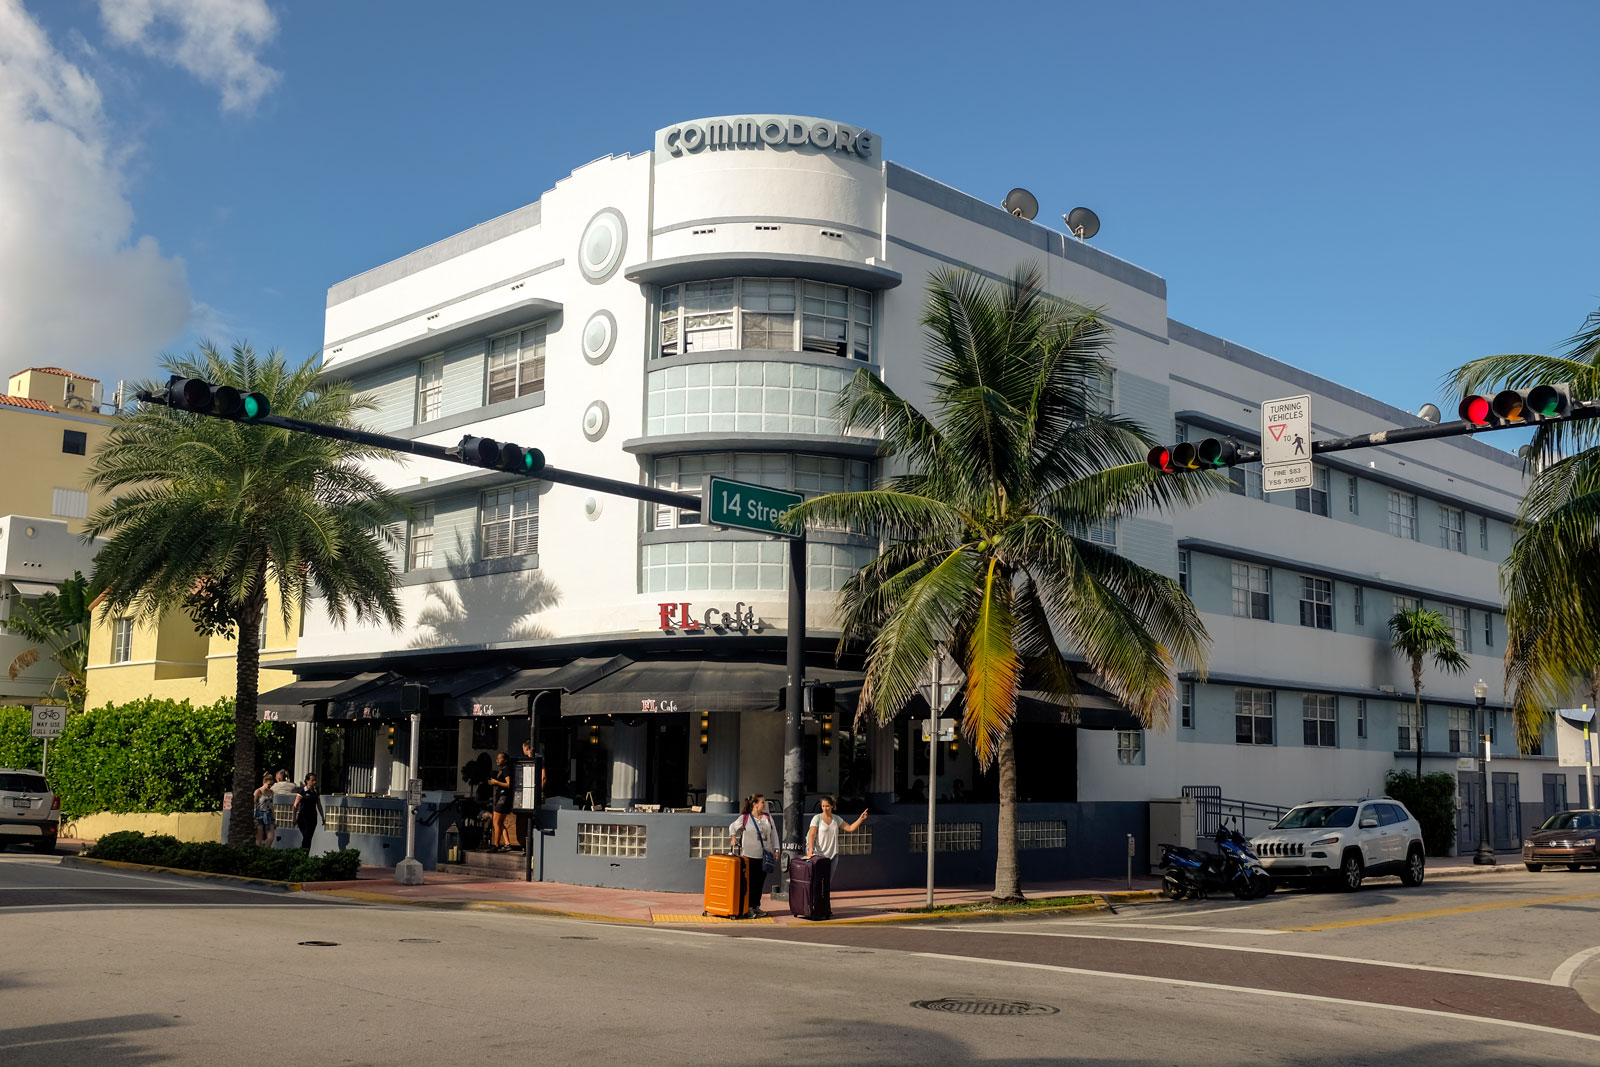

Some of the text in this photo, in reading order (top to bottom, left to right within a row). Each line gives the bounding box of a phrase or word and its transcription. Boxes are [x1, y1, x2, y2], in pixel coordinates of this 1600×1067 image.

[664, 118, 873, 157] COMMODORE
[1268, 411, 1303, 422] VEHICLES
[1270, 403, 1301, 413] TURNING
[722, 490, 792, 523] 14 Stree
[657, 602, 699, 630] FL
